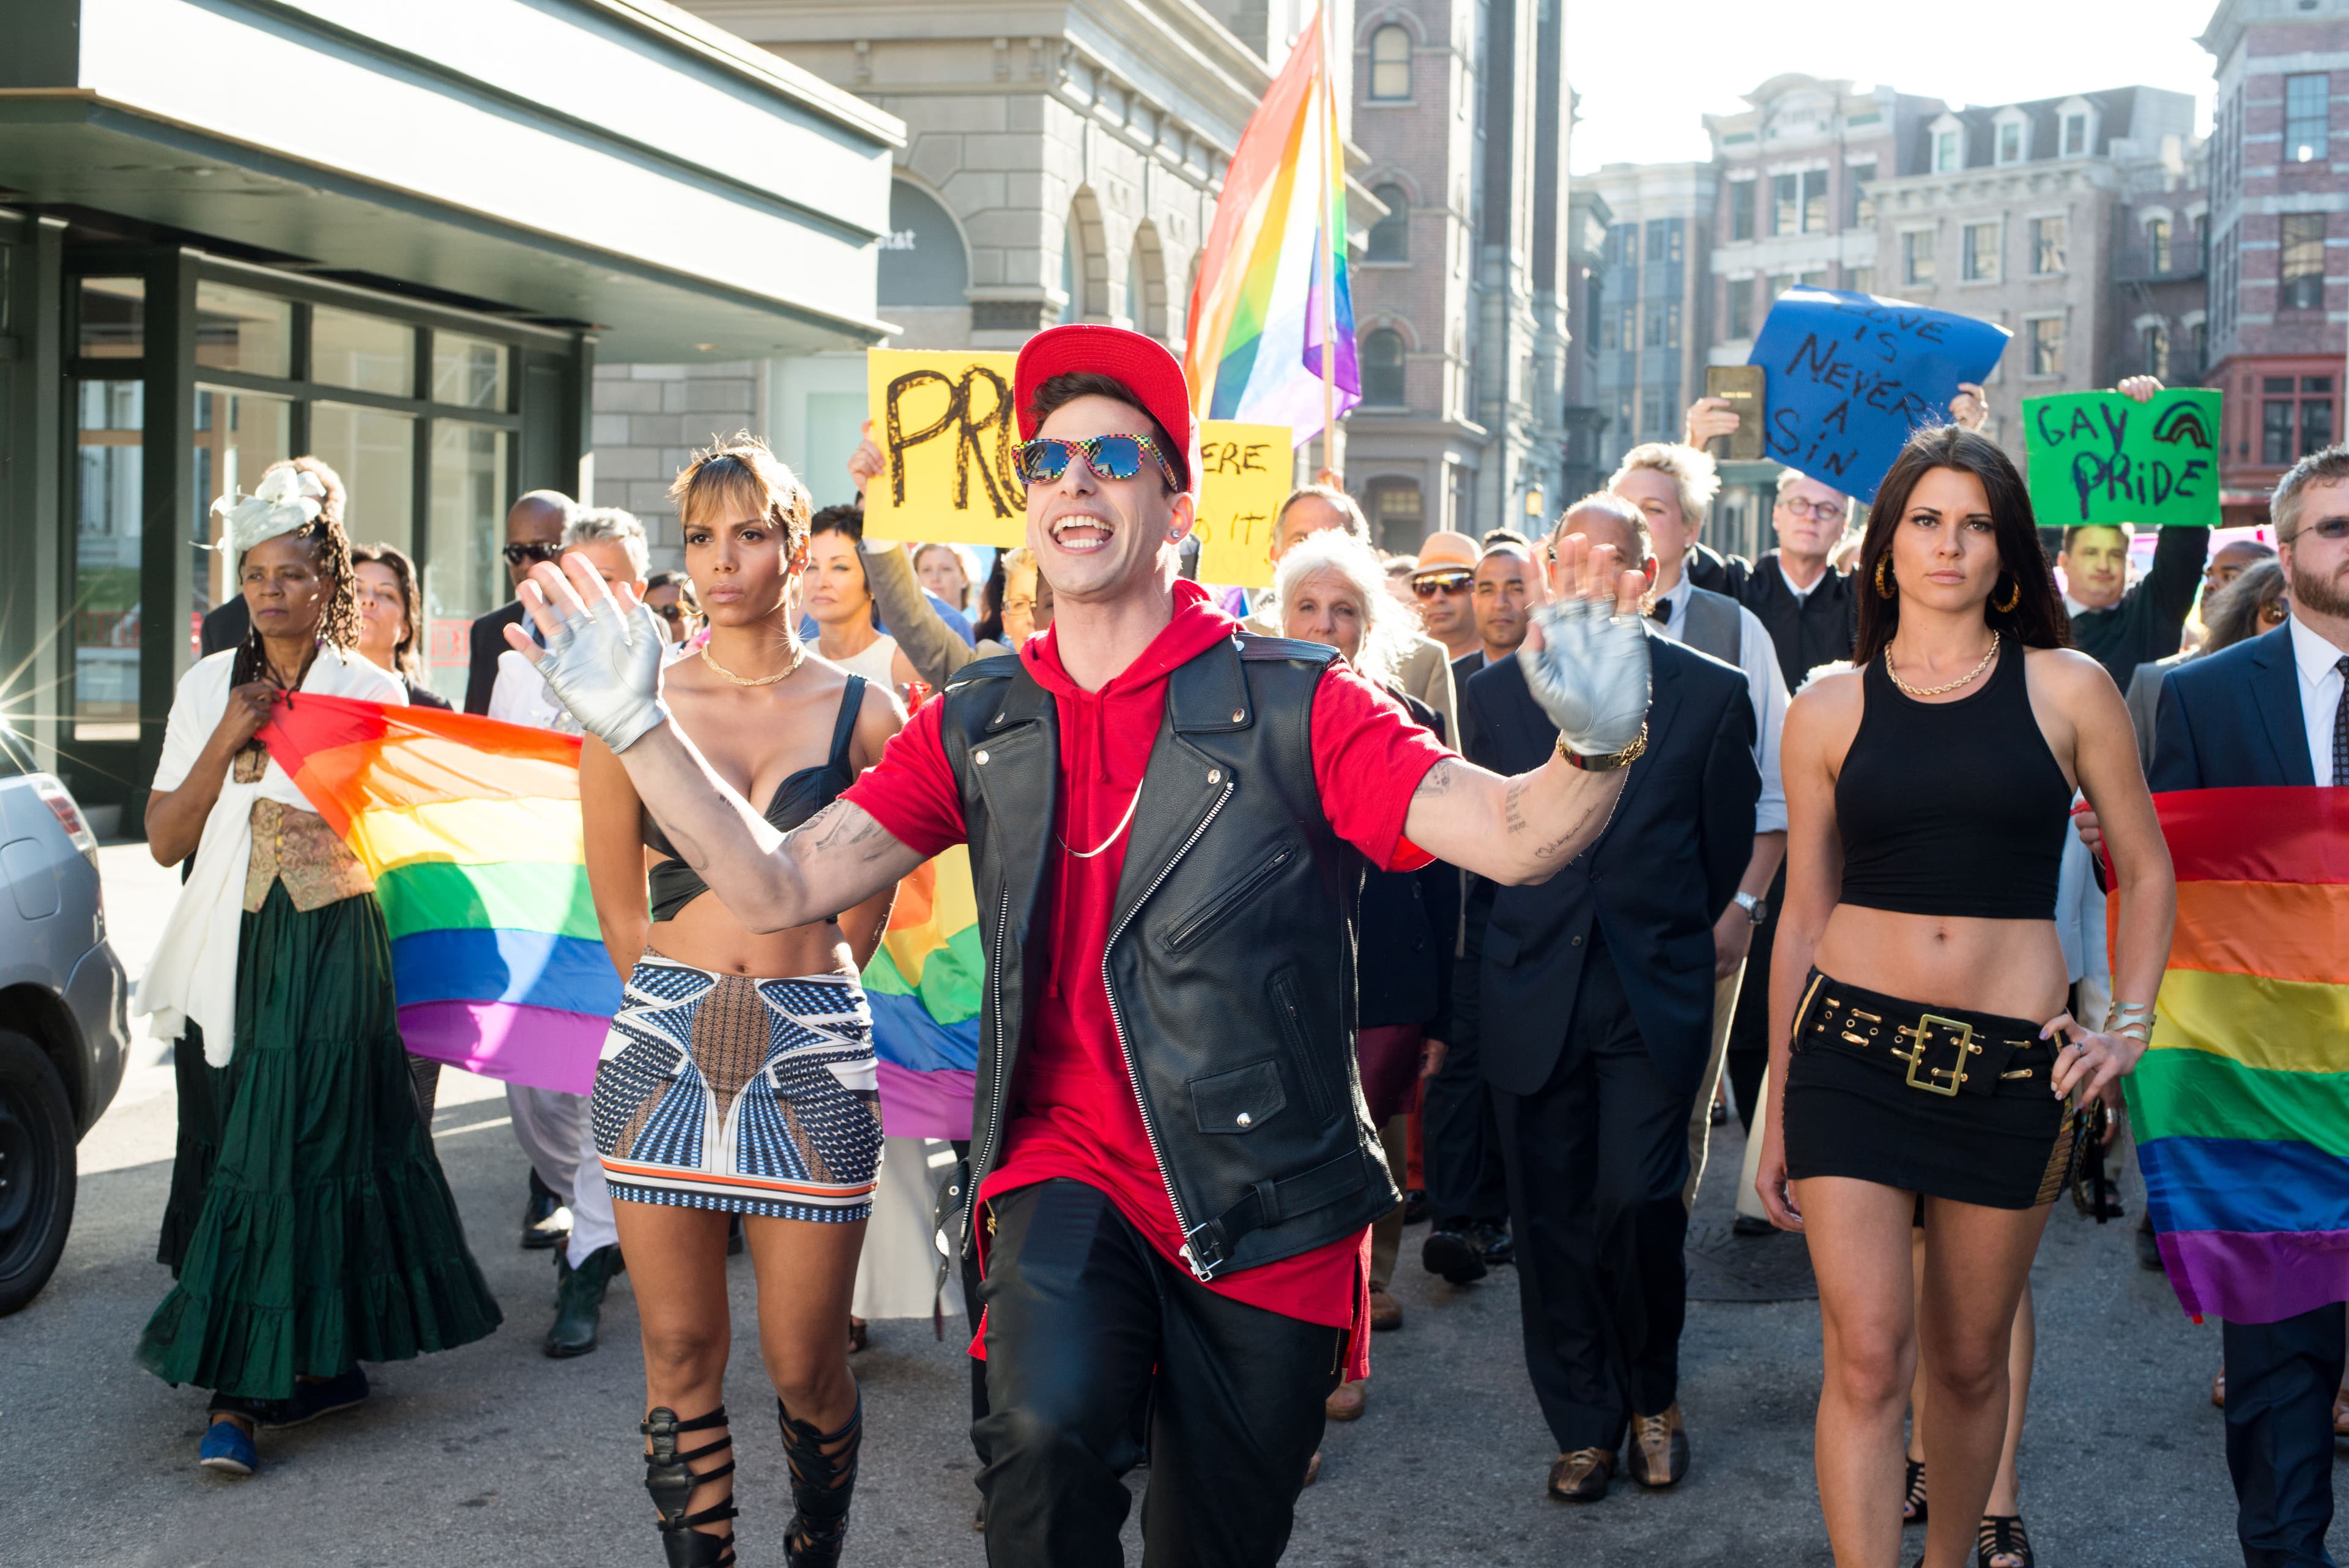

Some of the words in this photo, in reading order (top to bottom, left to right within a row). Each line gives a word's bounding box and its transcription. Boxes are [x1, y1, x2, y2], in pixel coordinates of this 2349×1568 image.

[1784, 332, 1926, 430] NEVER
[1822, 398, 1849, 435] A
[2038, 402, 2128, 453] GAY
